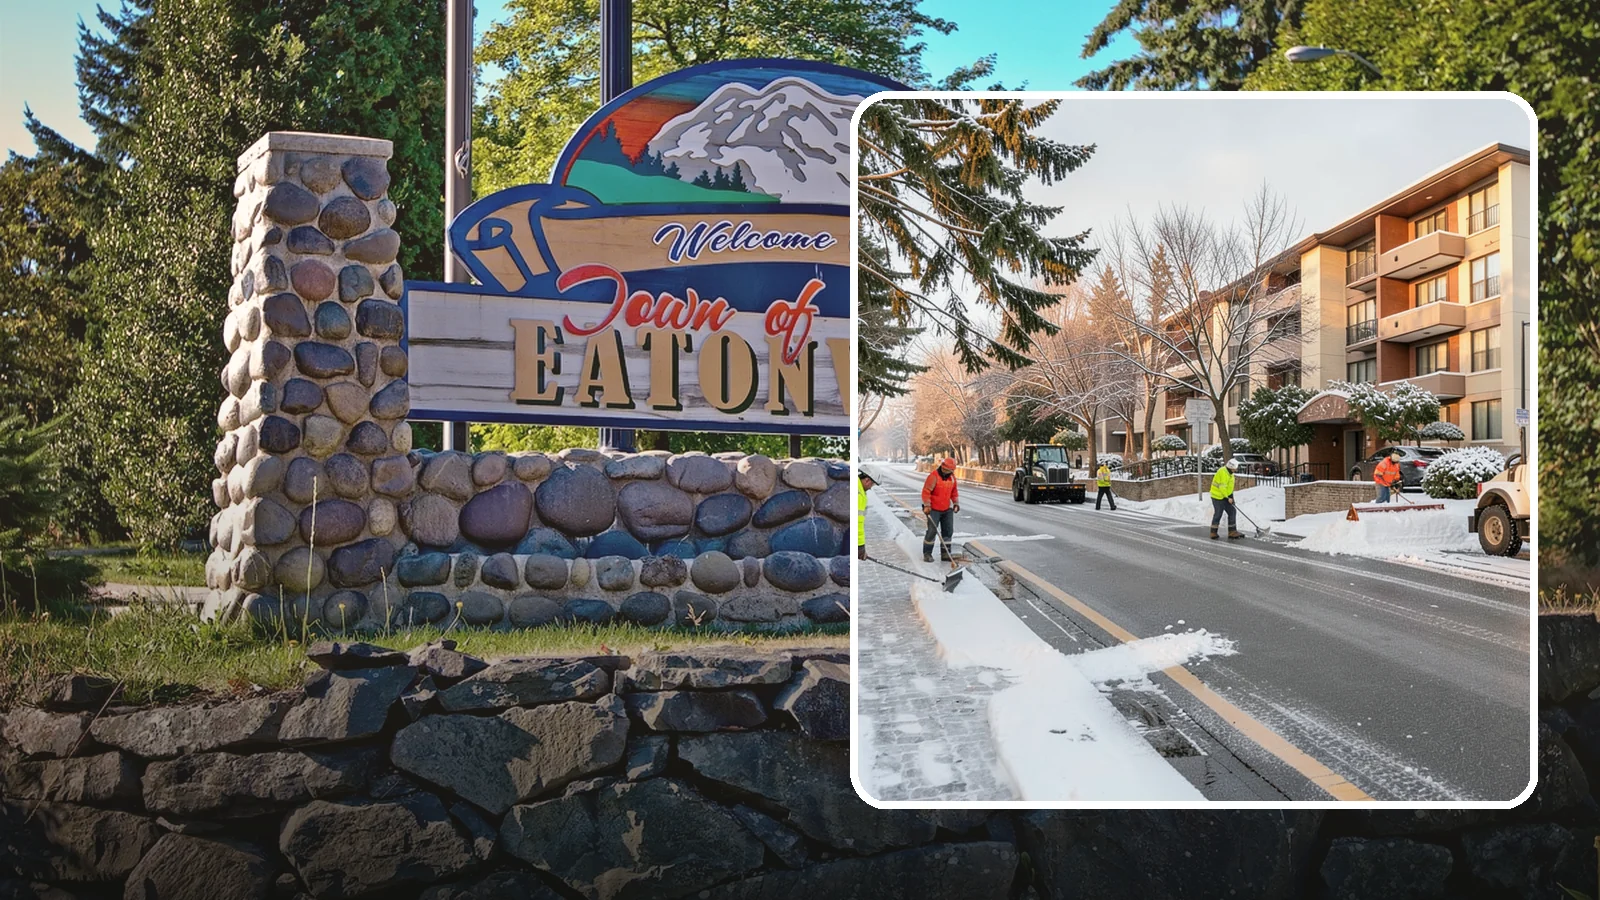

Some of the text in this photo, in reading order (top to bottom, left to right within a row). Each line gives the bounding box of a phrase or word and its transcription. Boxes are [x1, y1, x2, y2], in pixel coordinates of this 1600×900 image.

[653, 220, 837, 263] Welcome
[557, 263, 826, 365] Town of
